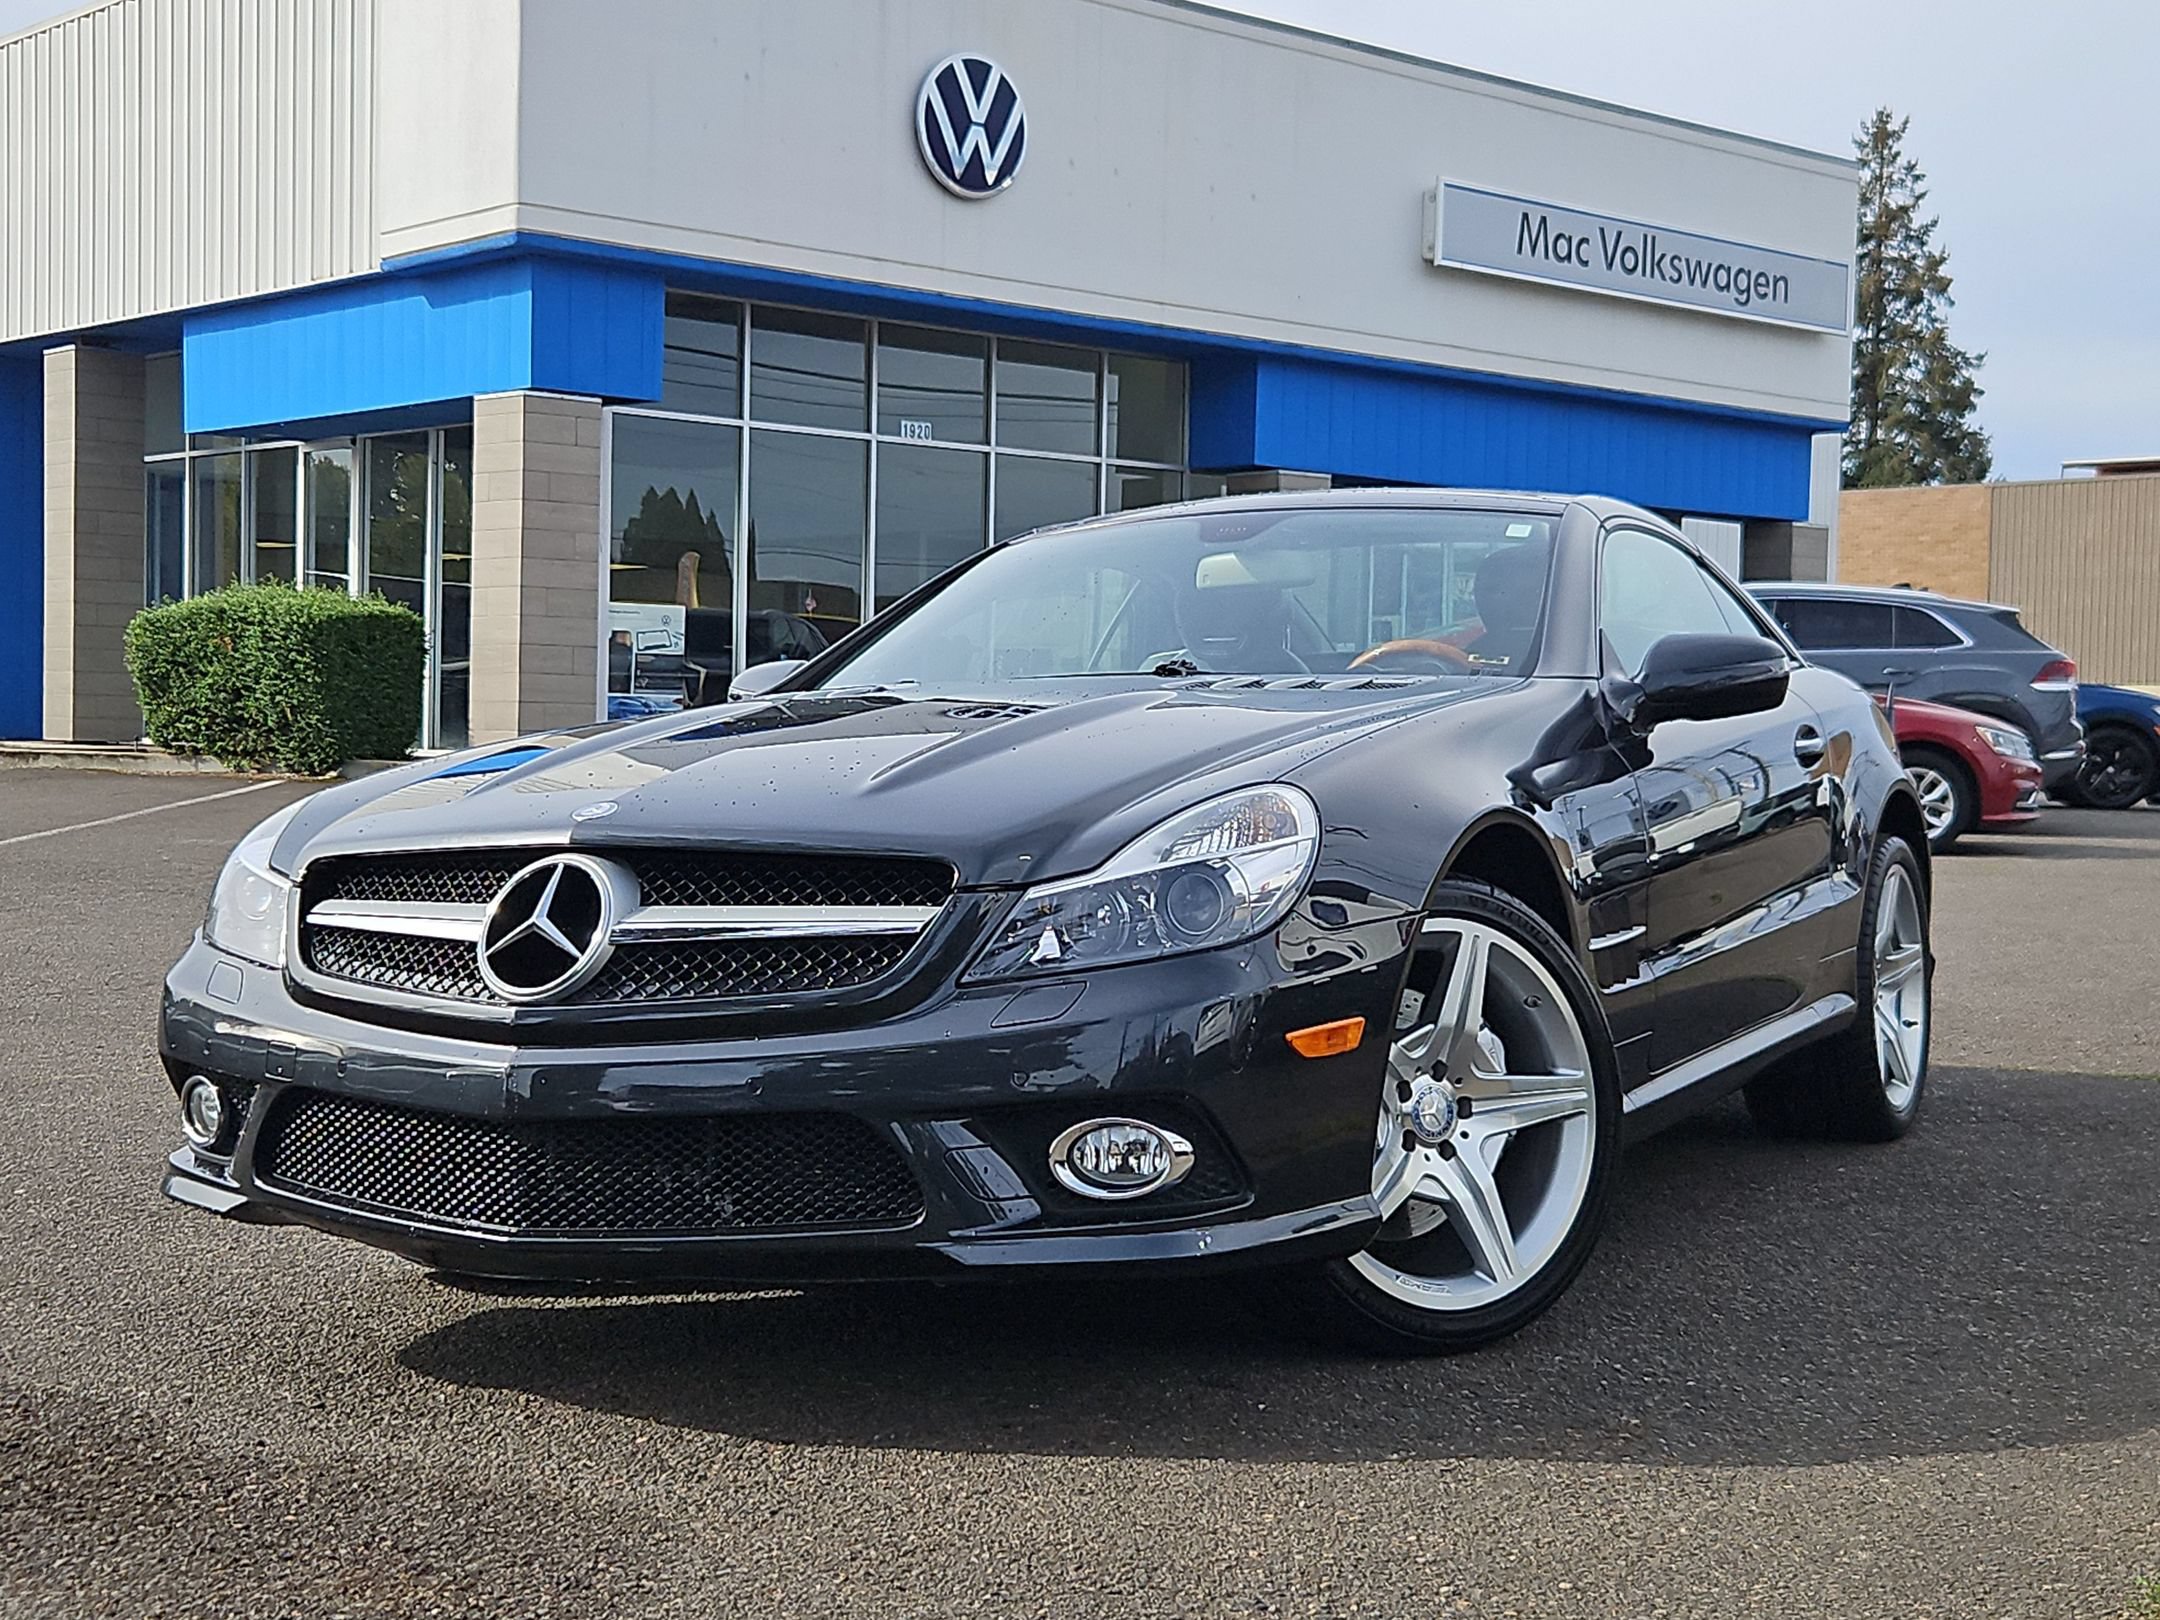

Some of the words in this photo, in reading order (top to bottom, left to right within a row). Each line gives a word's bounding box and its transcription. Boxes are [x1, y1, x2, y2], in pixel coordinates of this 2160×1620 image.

[926, 57, 1023, 187] VW
[1516, 211, 1590, 268] Mac
[1598, 226, 1790, 307] Volkswagen
[903, 423, 931, 440] 1920
